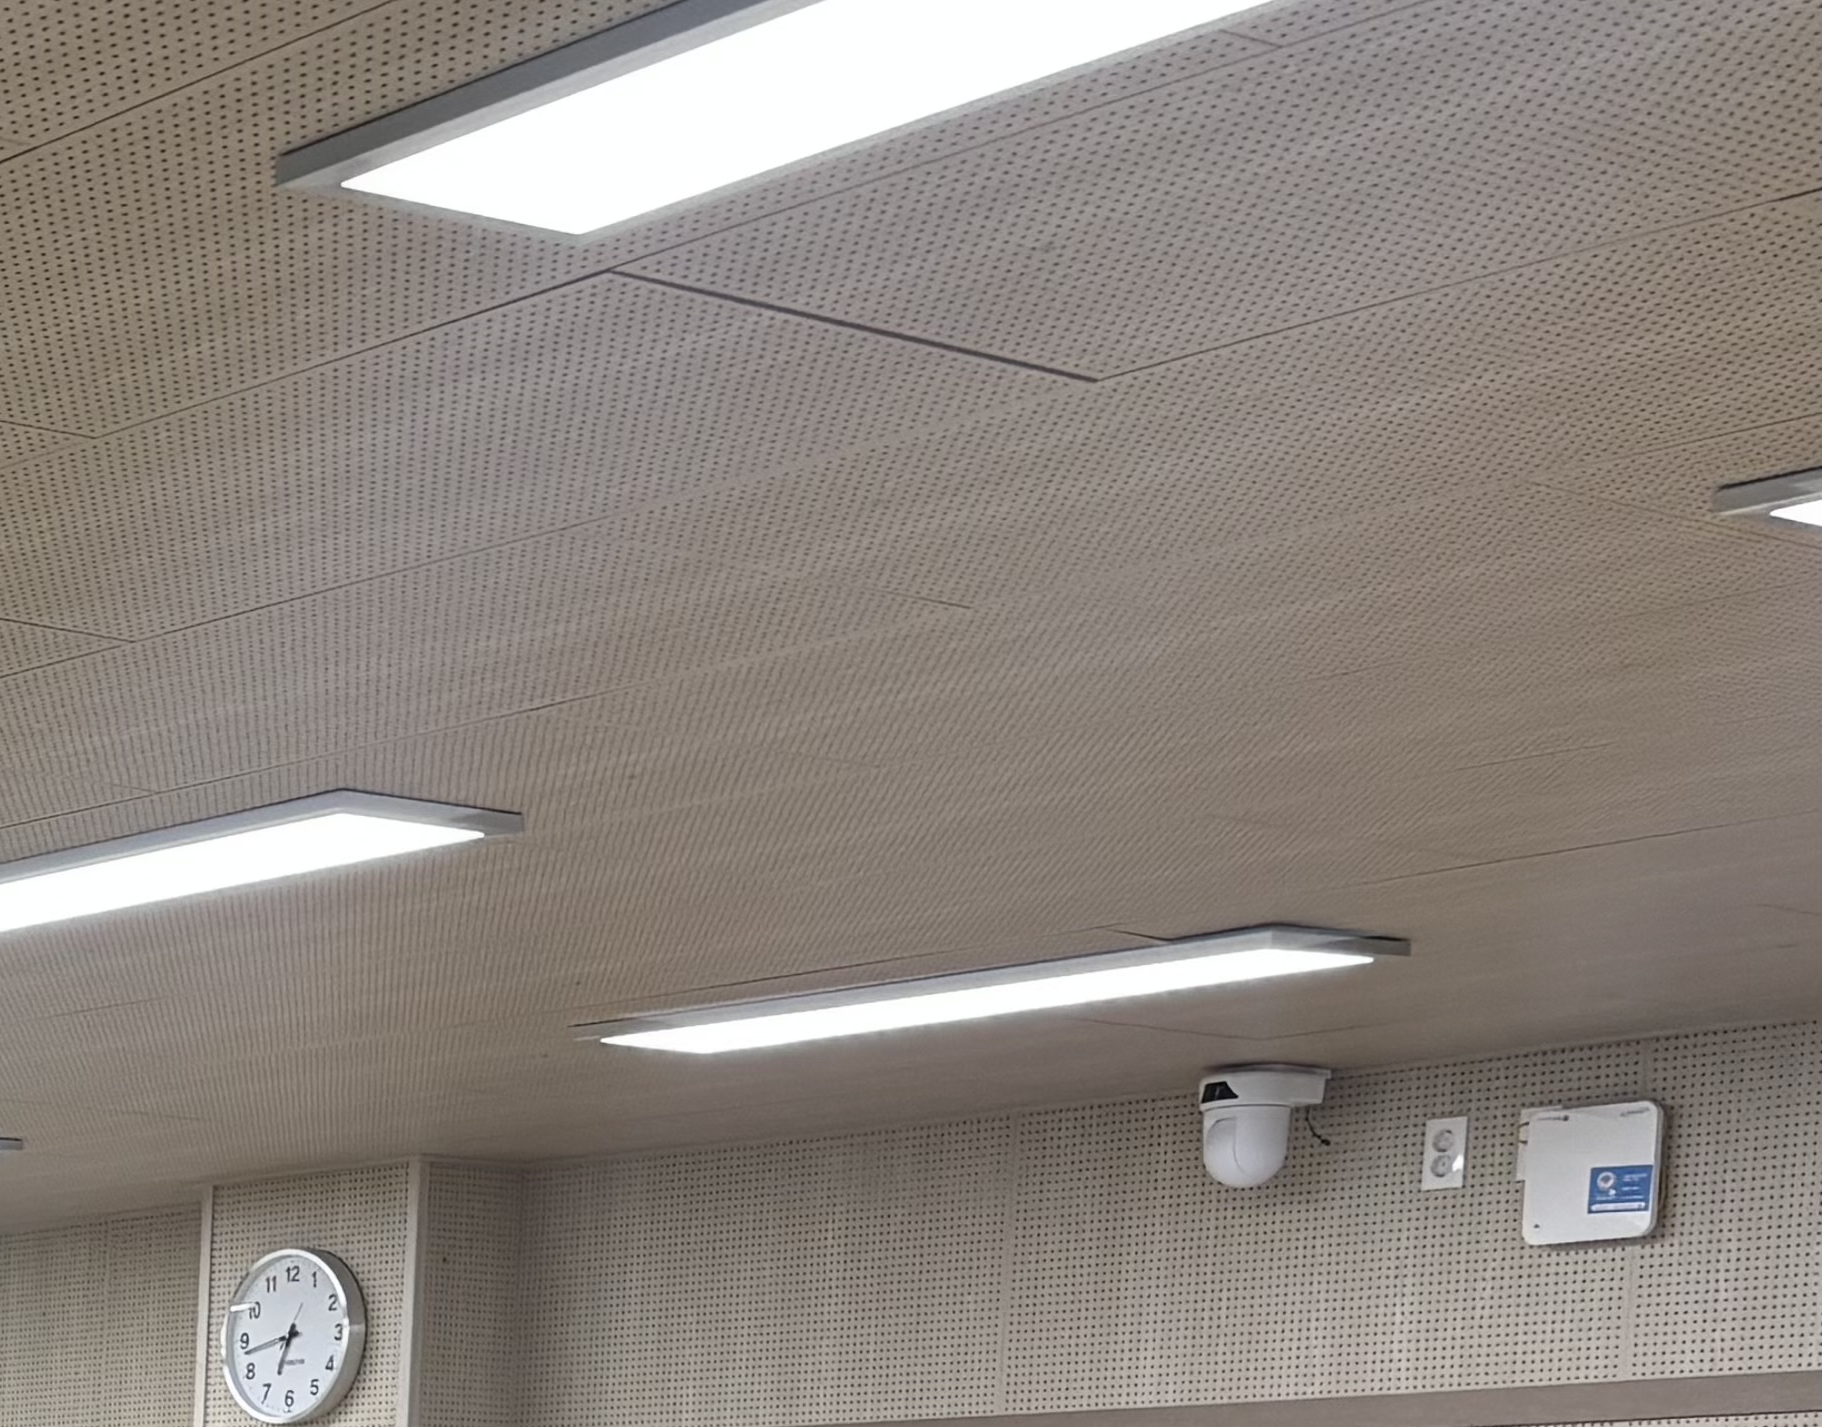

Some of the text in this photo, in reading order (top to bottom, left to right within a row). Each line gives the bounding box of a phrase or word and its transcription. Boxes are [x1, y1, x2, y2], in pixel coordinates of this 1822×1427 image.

[285, 1265, 300, 1282] 12
[311, 1271, 317, 1288] 1
[265, 1275, 277, 1293] 11
[248, 1301, 261, 1319] 10
[328, 1294, 338, 1311] 2
[239, 1332, 250, 1349] 9
[334, 1323, 343, 1341] 3
[245, 1362, 256, 1380] 8
[325, 1355, 334, 1371] 4
[261, 1383, 272, 1404] 7
[309, 1379, 319, 1396] 5
[284, 1390, 295, 1407] 6
